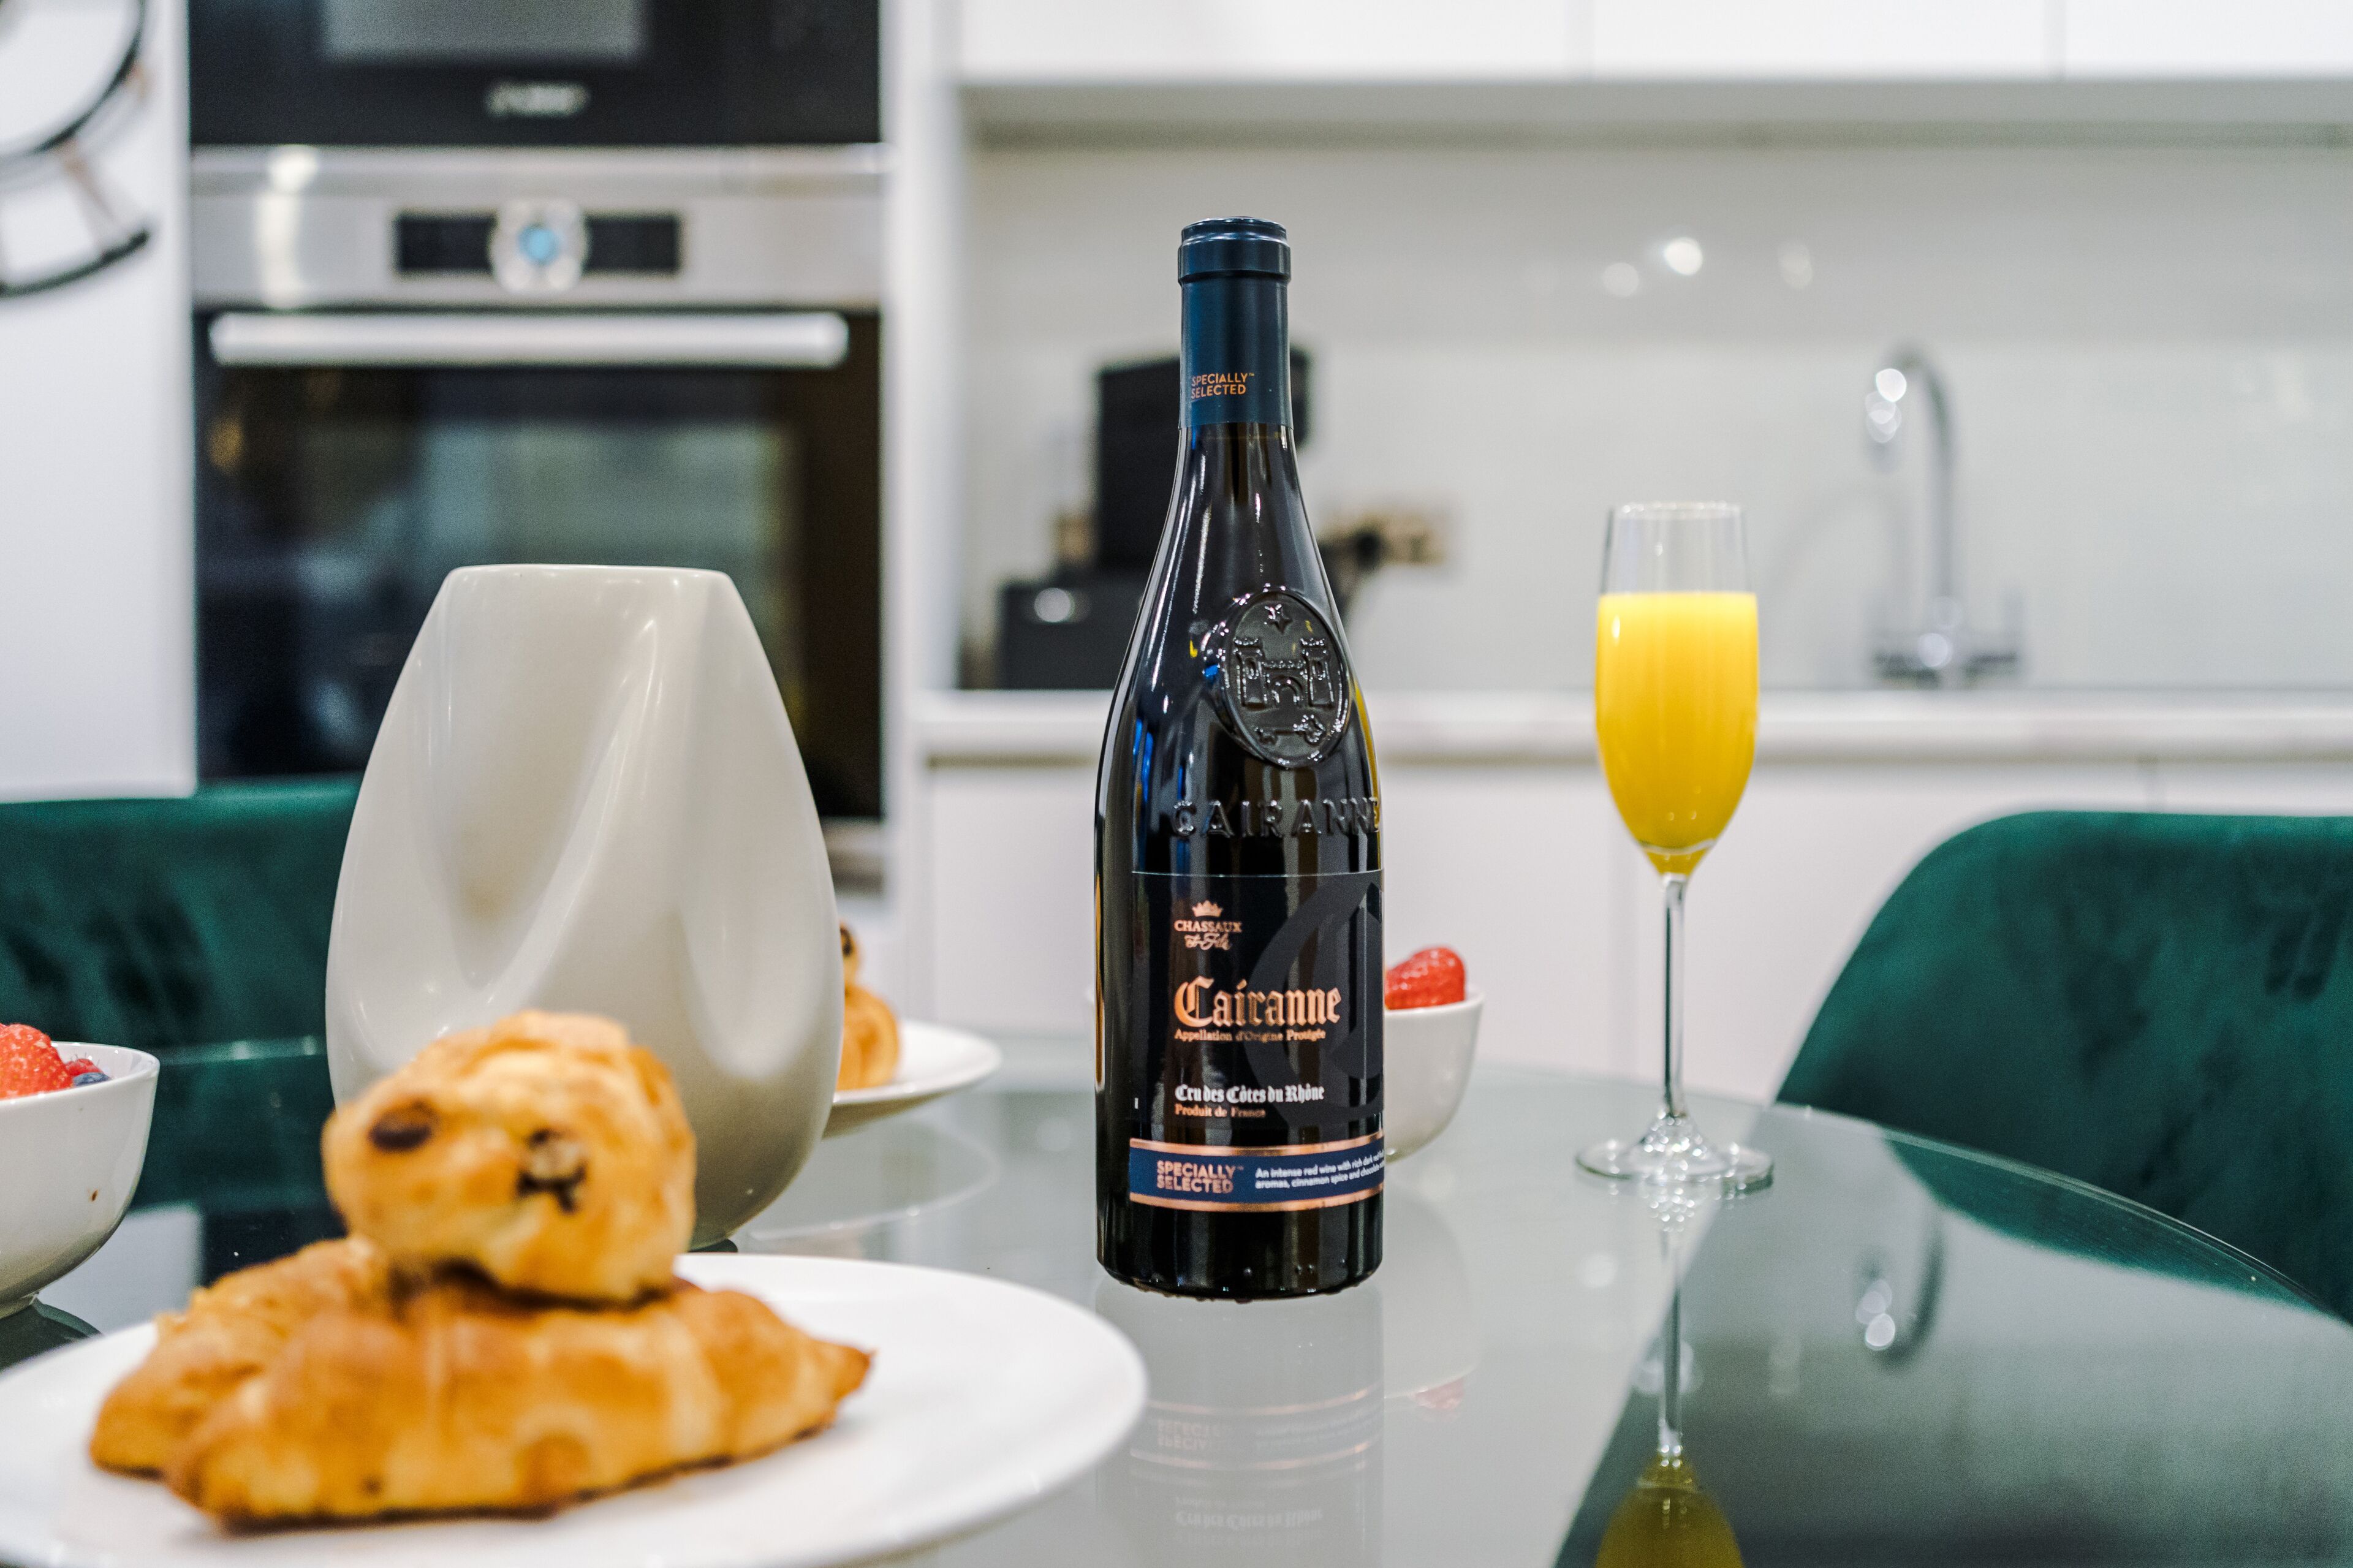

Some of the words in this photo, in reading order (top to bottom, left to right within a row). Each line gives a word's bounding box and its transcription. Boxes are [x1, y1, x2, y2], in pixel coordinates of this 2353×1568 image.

[1191, 384, 1246, 399] SELECTED
[1173, 919, 1243, 933] CHASSAUX
[1174, 975, 1342, 1028] Cairanne
[1174, 1028, 1233, 1042] Appellation
[1175, 1083, 1202, 1102] Cru
[1203, 1085, 1225, 1103] des
[1267, 1085, 1284, 1103] du
[1175, 1102, 1213, 1118] Produit
[1214, 1105, 1228, 1118] de
[1255, 1166, 1270, 1178] An
[1270, 1167, 1303, 1178] intense
[1303, 1164, 1318, 1176] red
[1319, 1164, 1336, 1175] wine
[1337, 1160, 1352, 1172] with
[1290, 1175, 1330, 1187] cinnamon
[1330, 1173, 1349, 1185] spice
[1349, 1168, 1360, 1180] and
[1157, 1173, 1234, 1194] SELECTED
